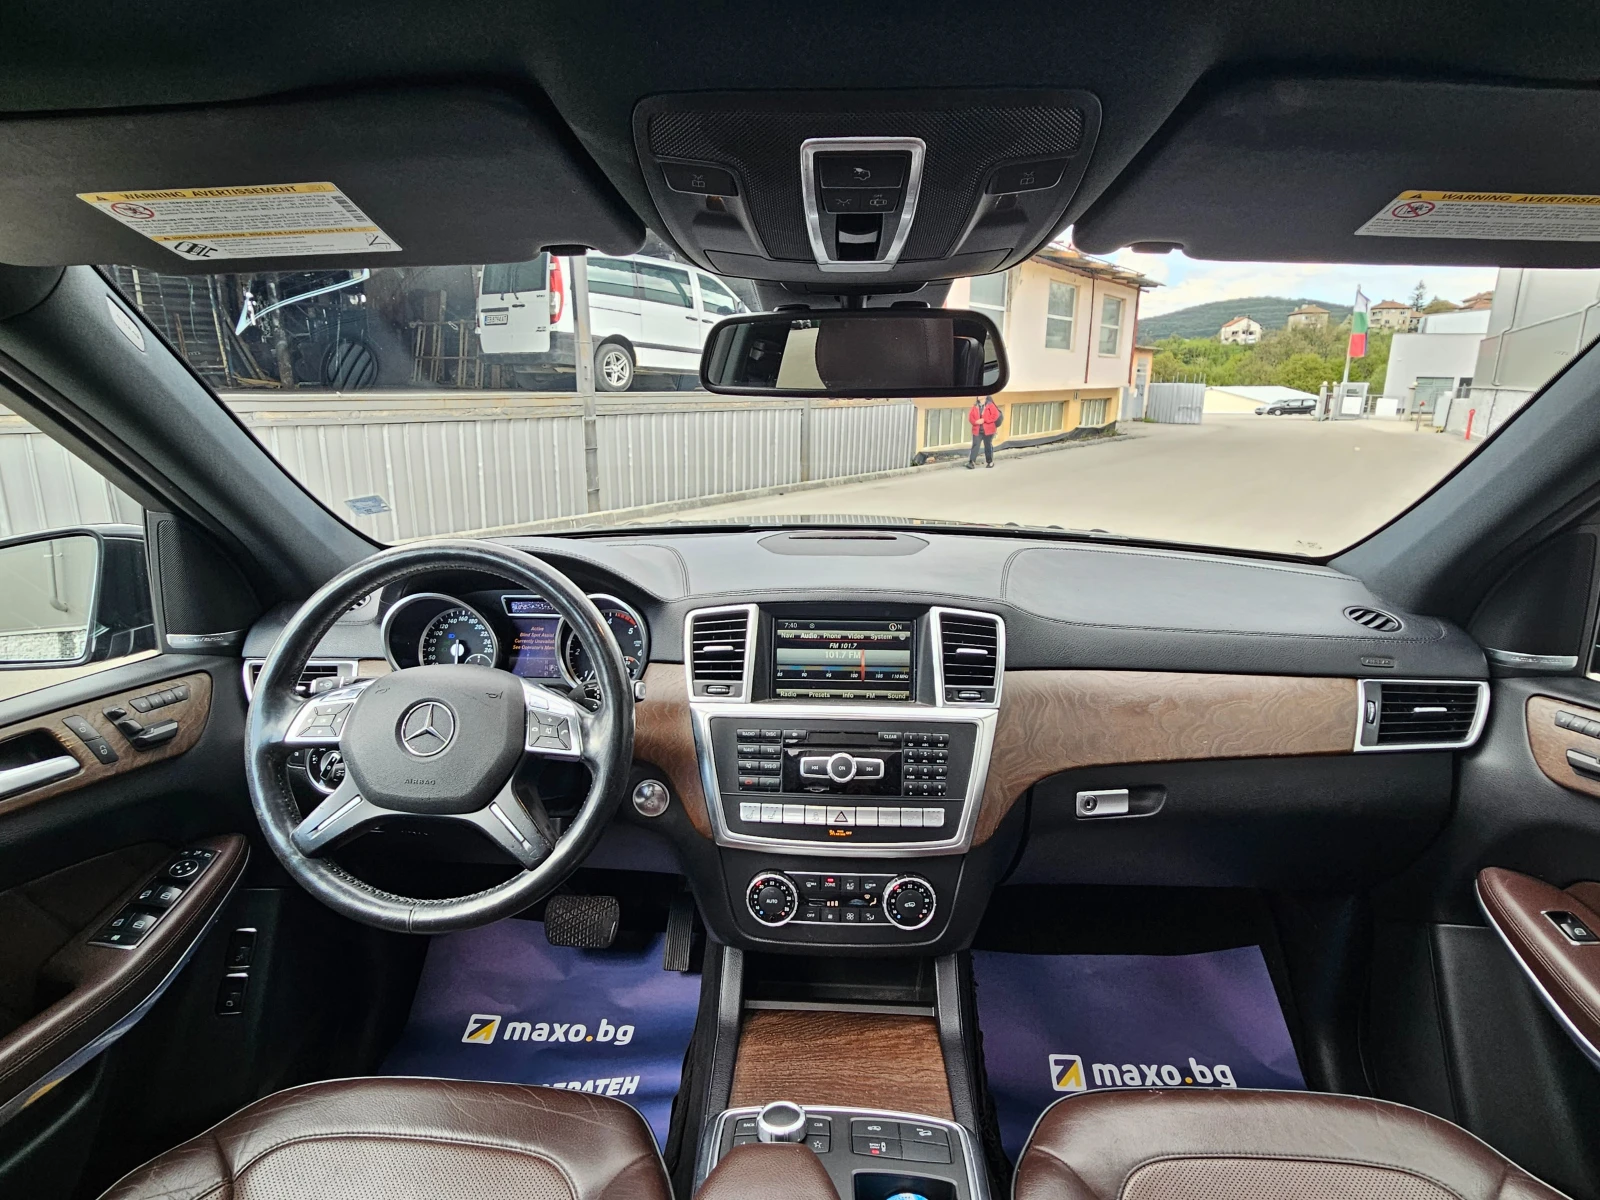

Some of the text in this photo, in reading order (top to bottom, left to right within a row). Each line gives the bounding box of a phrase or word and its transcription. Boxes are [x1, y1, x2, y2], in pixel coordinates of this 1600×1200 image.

[120, 185, 297, 200] WARNING AVERTISSEMENT
[1441, 193, 1512, 201] WARNING
[870, 633, 893, 641] System
[825, 651, 861, 659] 101.7 FM
[404, 778, 436, 786] AIRBAG
[503, 1018, 635, 1046] maxo.bg
[1091, 1057, 1237, 1088] maxo.bg
